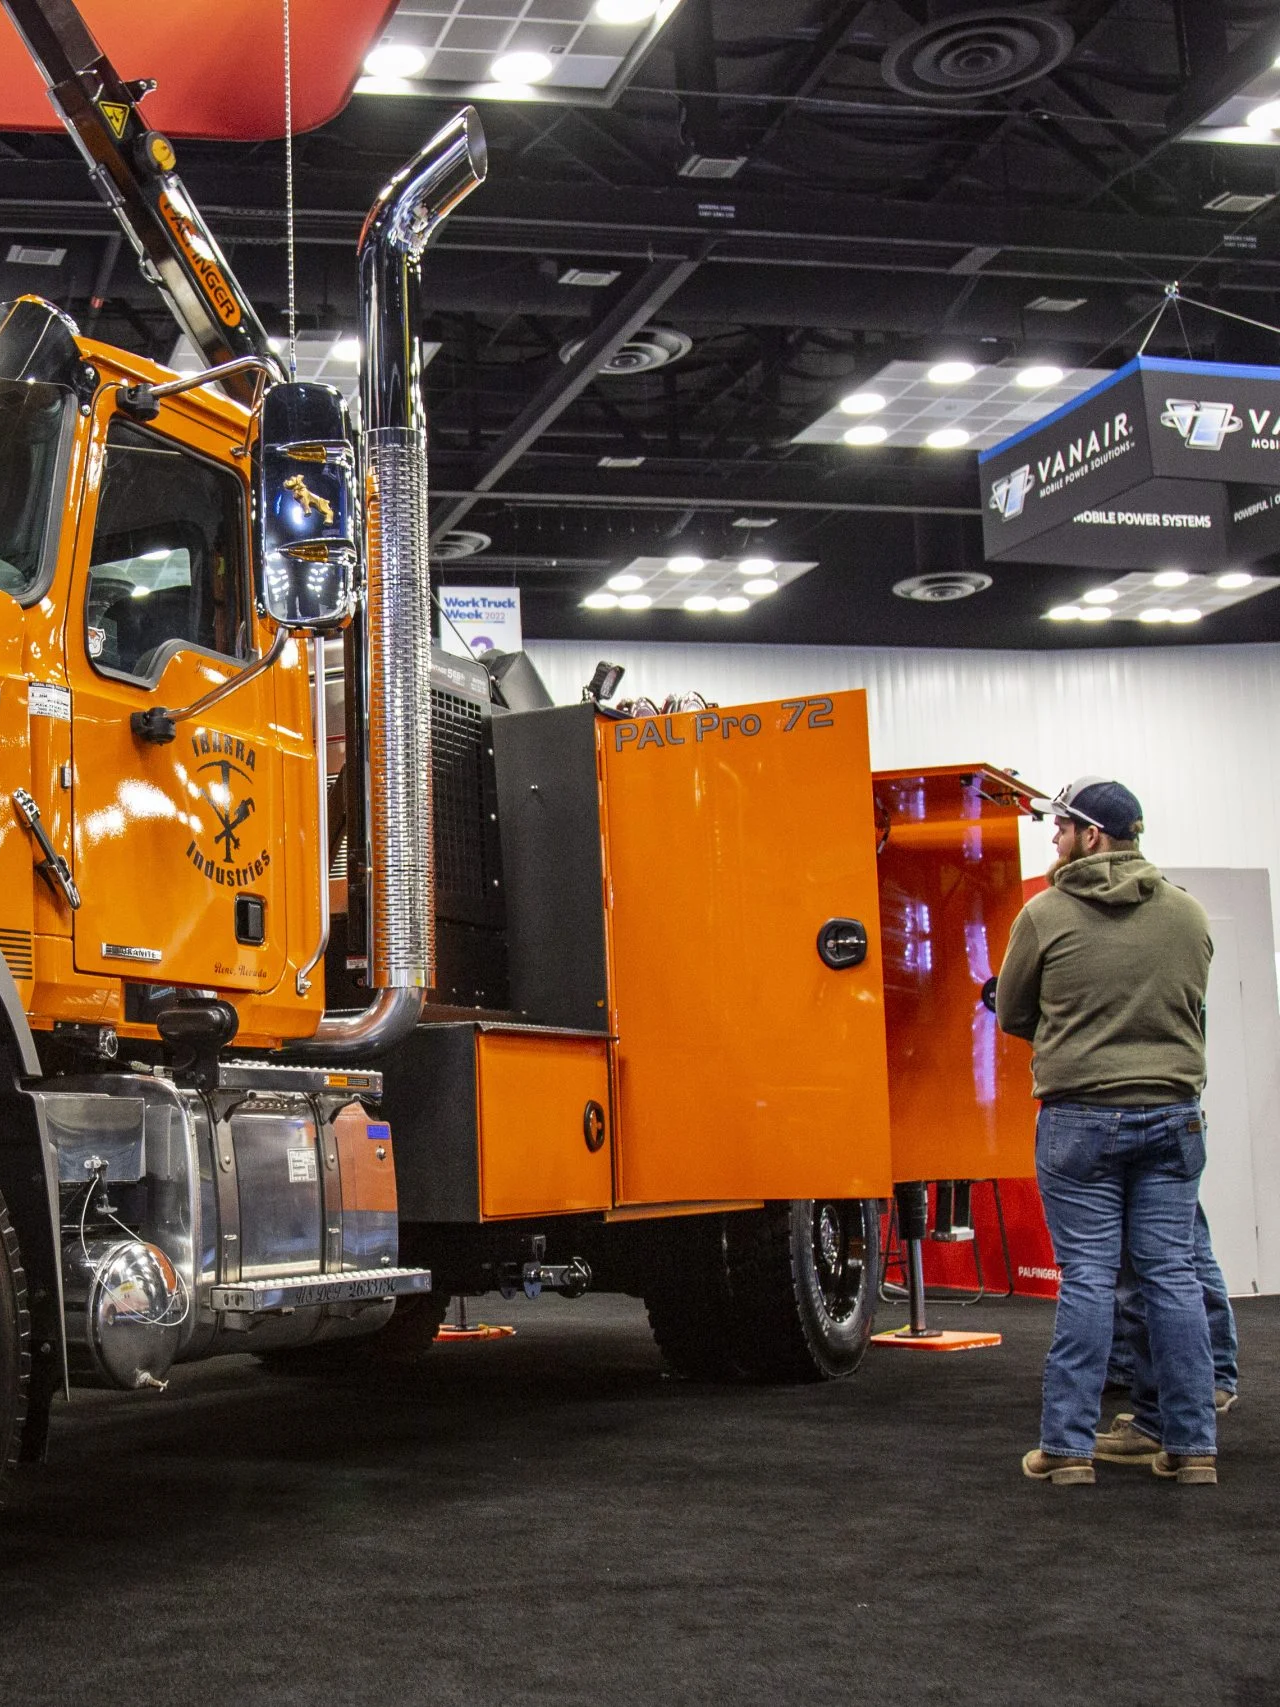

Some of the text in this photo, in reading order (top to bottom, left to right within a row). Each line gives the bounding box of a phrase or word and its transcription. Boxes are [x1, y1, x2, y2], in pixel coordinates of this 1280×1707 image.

[1039, 478, 1063, 499] MOBILE
[1065, 464, 1089, 486] POWER
[1117, 511, 1161, 527] POWER
[1161, 513, 1212, 528] SYSTEMS
[1233, 500, 1269, 523] POWERFUL
[445, 609, 506, 621] Week 2022
[614, 698, 834, 752] PAL Pro 72
[192, 732, 256, 772] IBARRA
[186, 840, 271, 888] Industries
[122, 947, 157, 959] GRANITE
